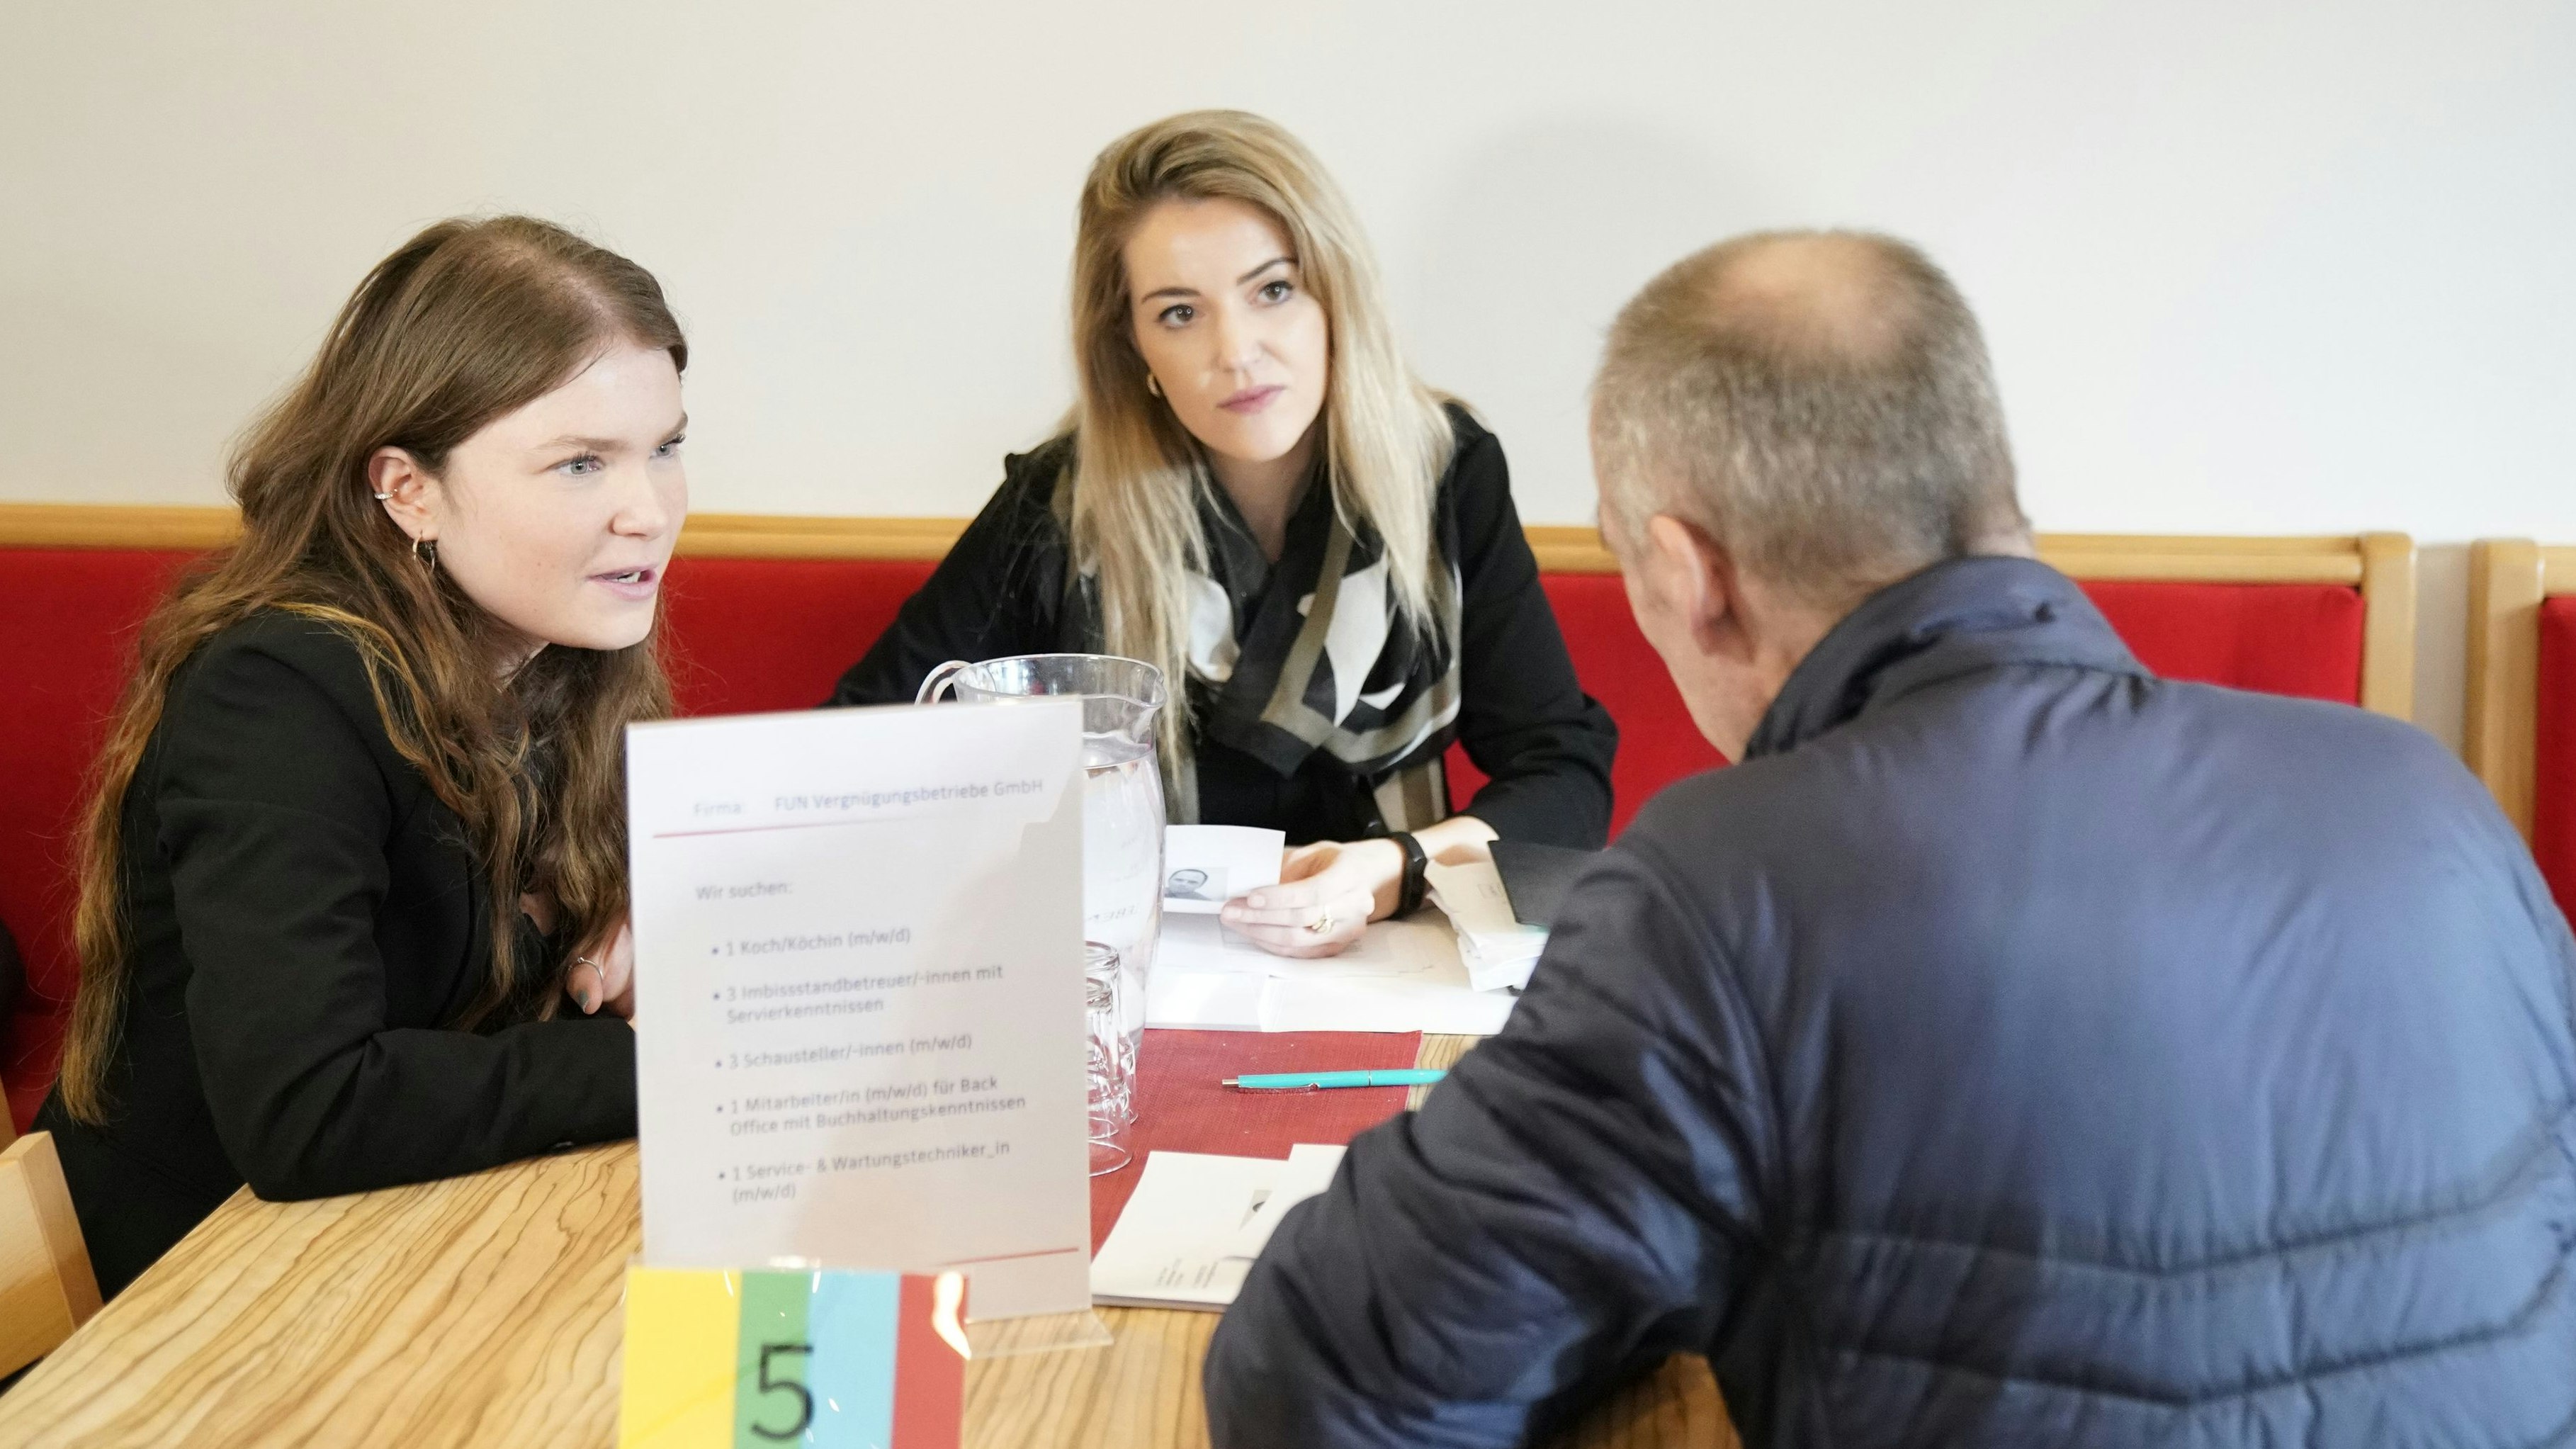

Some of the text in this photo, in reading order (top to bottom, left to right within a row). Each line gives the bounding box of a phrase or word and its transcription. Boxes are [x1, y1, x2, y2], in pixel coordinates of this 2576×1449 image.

[776, 795, 808, 811] FUN
[813, 784, 989, 810] Vergnügungsbetriebe
[994, 779, 1044, 797] GmbH
[696, 881, 793, 900] Wir suchen:
[726, 927, 911, 957] 1 Koch/Köchin (m/w/d)
[727, 986, 736, 1002] 3
[976, 966, 1004, 980] mit
[728, 998, 884, 1025] Servierkenntnissen
[730, 1033, 973, 1070] 3 Schausteller/-innen (m/w/d)
[731, 1076, 998, 1114] 1 Mitarbeiter/in (m/w/d) für Back
[730, 1096, 1026, 1137] Office mit Buchhaltungskenntnissen
[733, 1167, 740, 1181] 1
[817, 1158, 827, 1173] &
[832, 1139, 1011, 1171] Wartungstechniker_in
[732, 1182, 796, 1204] (m/w/d)
[750, 1343, 814, 1440] 5
